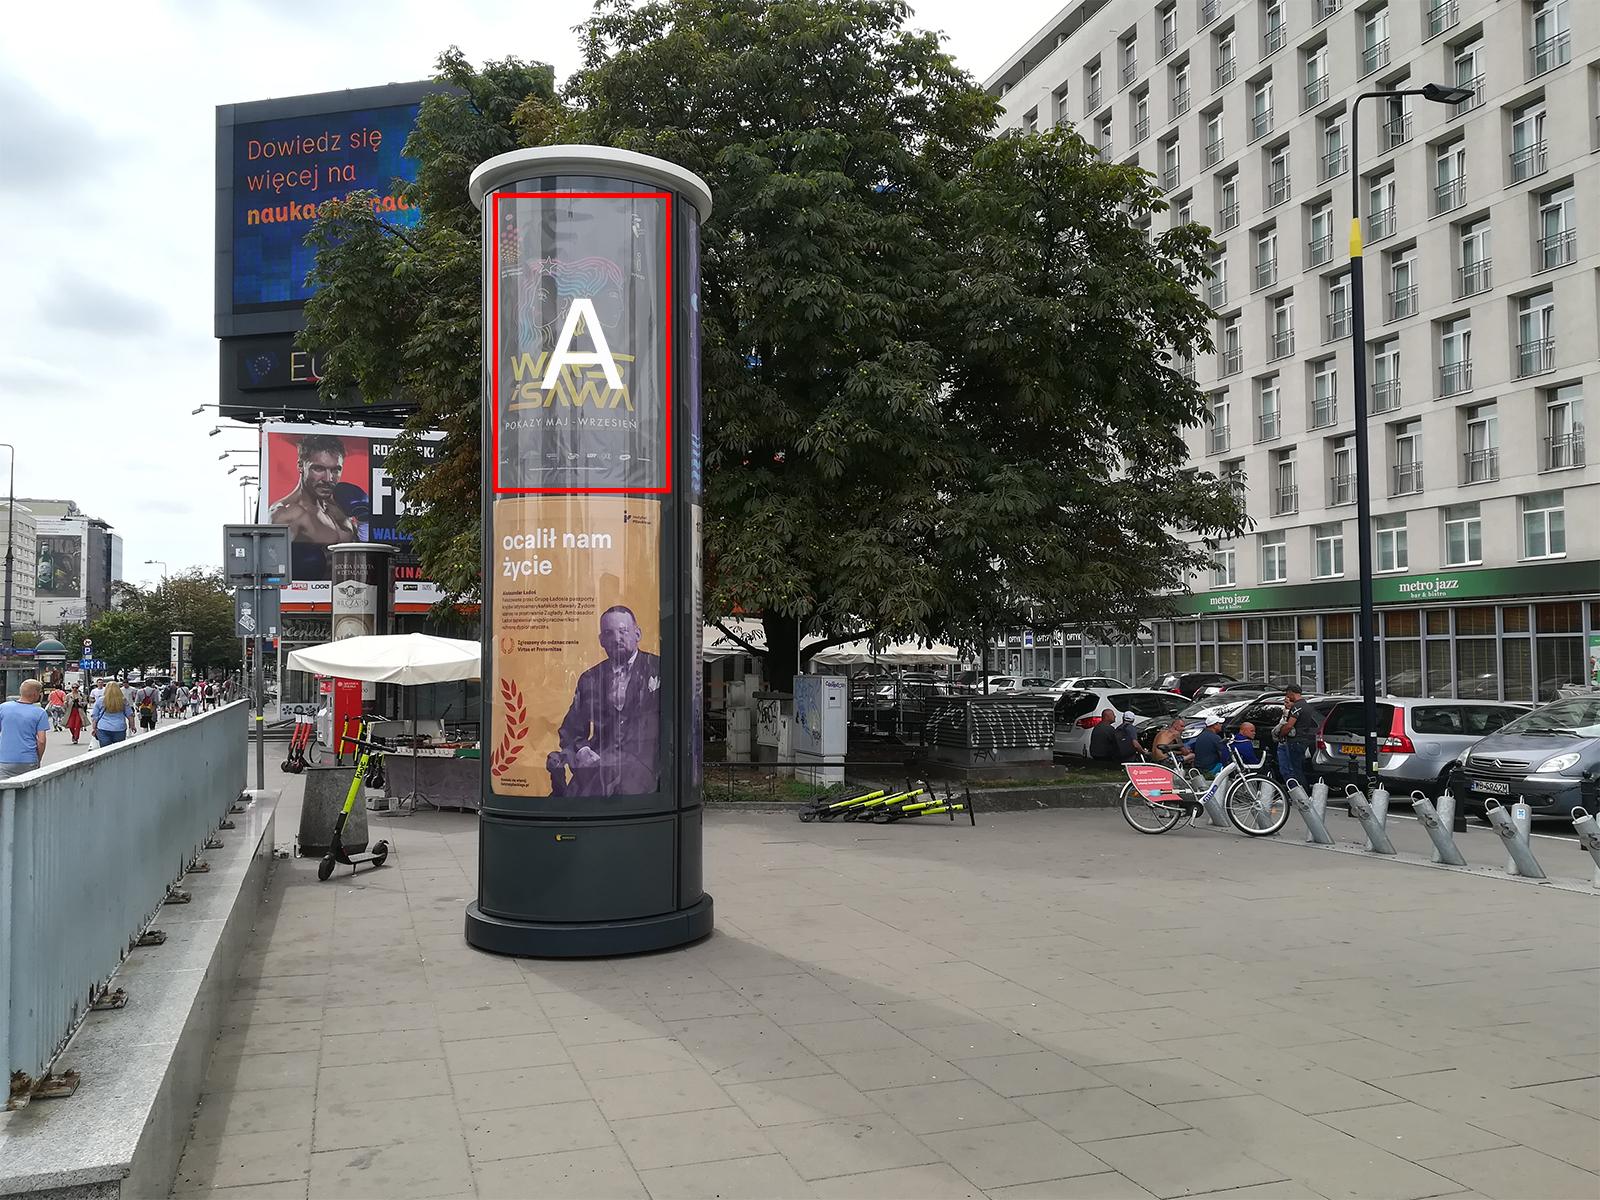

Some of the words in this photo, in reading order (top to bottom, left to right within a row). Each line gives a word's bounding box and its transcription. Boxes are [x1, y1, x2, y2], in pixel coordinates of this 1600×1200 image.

[248, 131, 341, 160] Dowiedz
[350, 127, 382, 151] się
[247, 165, 318, 193] więcej
[328, 163, 356, 183] na
[508, 379, 634, 412] SAWA
[505, 418, 542, 430] POKAZY
[546, 417, 568, 427] MAJ
[578, 416, 637, 430] WRZESIEŃ
[502, 527, 557, 550] ocalił
[562, 532, 612, 549] nam
[502, 554, 553, 581] życie
[1398, 580, 1434, 592] metro
[1434, 577, 1459, 592] jazz
[1210, 595, 1233, 605] metro
[1233, 593, 1251, 605] jazz
